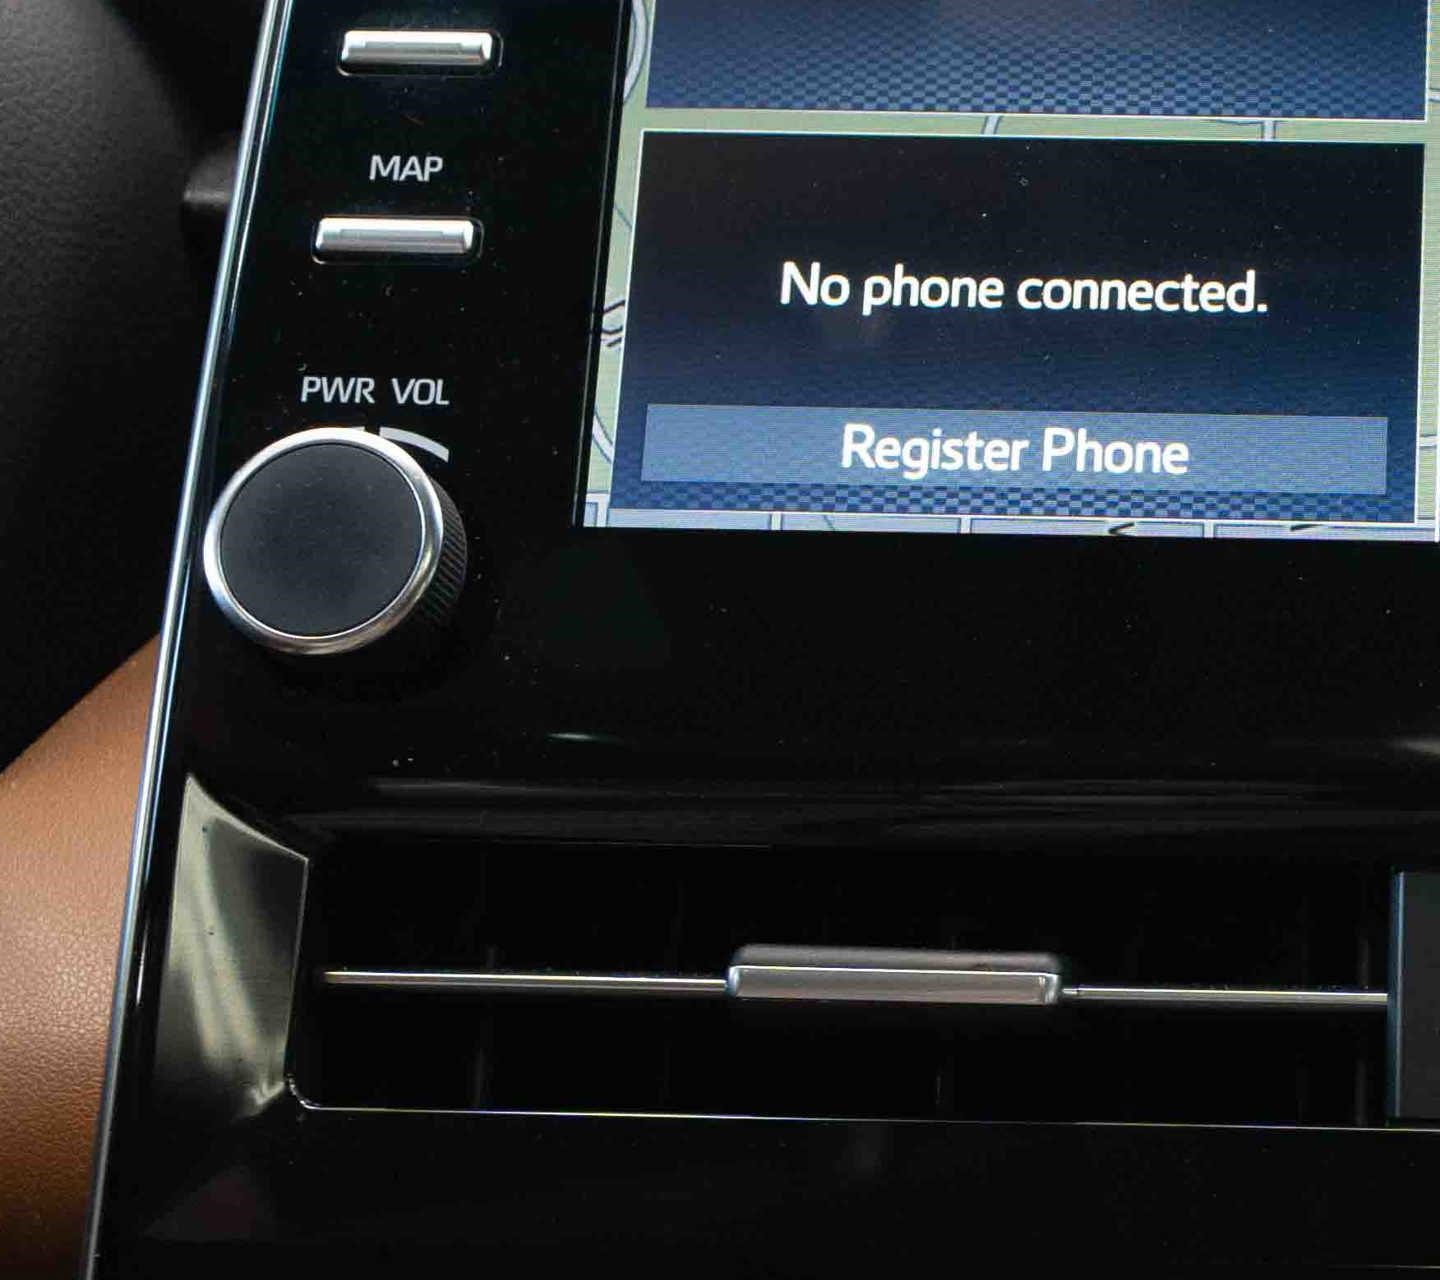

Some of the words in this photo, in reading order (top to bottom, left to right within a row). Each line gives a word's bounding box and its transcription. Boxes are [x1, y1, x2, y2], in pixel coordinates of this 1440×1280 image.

[369, 155, 443, 182] MAP
[780, 261, 850, 307] No
[862, 264, 1004, 316] phone
[1017, 269, 1268, 314] connected.
[301, 376, 375, 404] PWR
[392, 378, 449, 405] VOL
[841, 424, 1029, 480] Register
[1042, 428, 1189, 475] Phone
